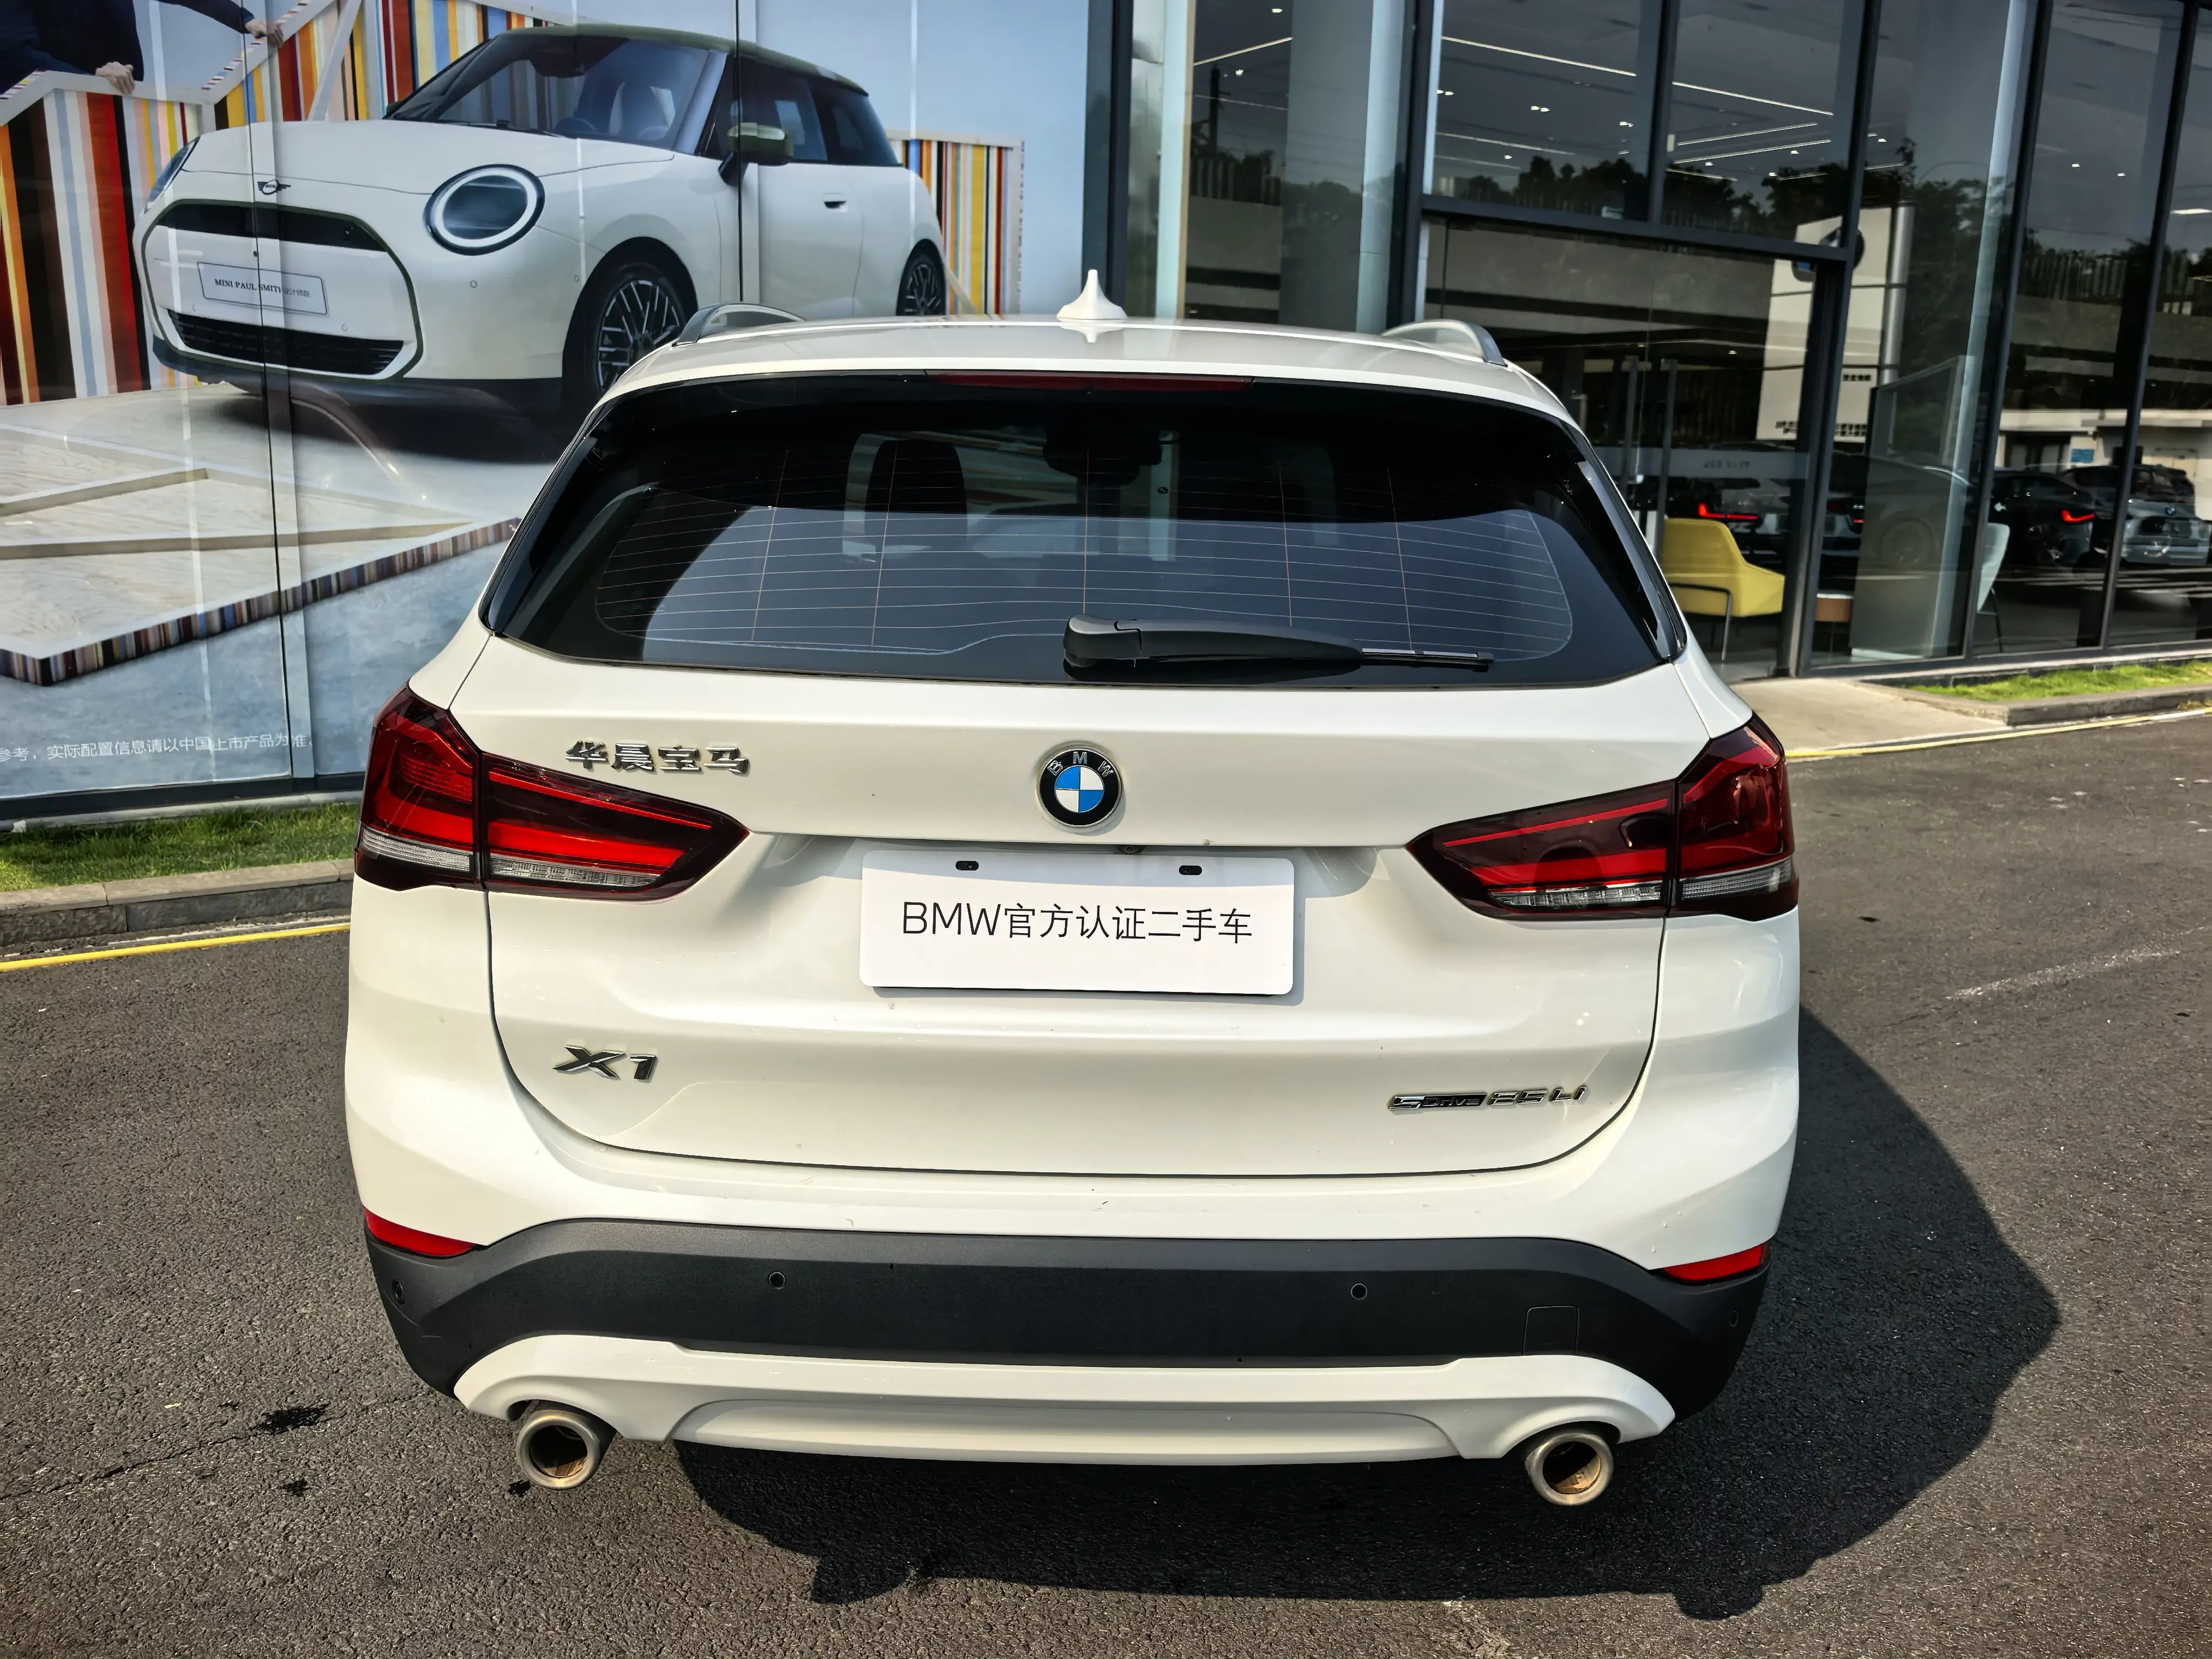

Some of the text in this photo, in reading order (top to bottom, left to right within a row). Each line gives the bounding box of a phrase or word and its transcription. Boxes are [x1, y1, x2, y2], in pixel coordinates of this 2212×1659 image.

[214, 279, 233, 287] MINI
[235, 281, 257, 291] PAUL
[565, 739, 748, 774] 华晨宝马
[1047, 751, 1114, 777] BMW
[902, 901, 1252, 944] BMW官方认证二手车
[553, 1044, 656, 1081] X1
